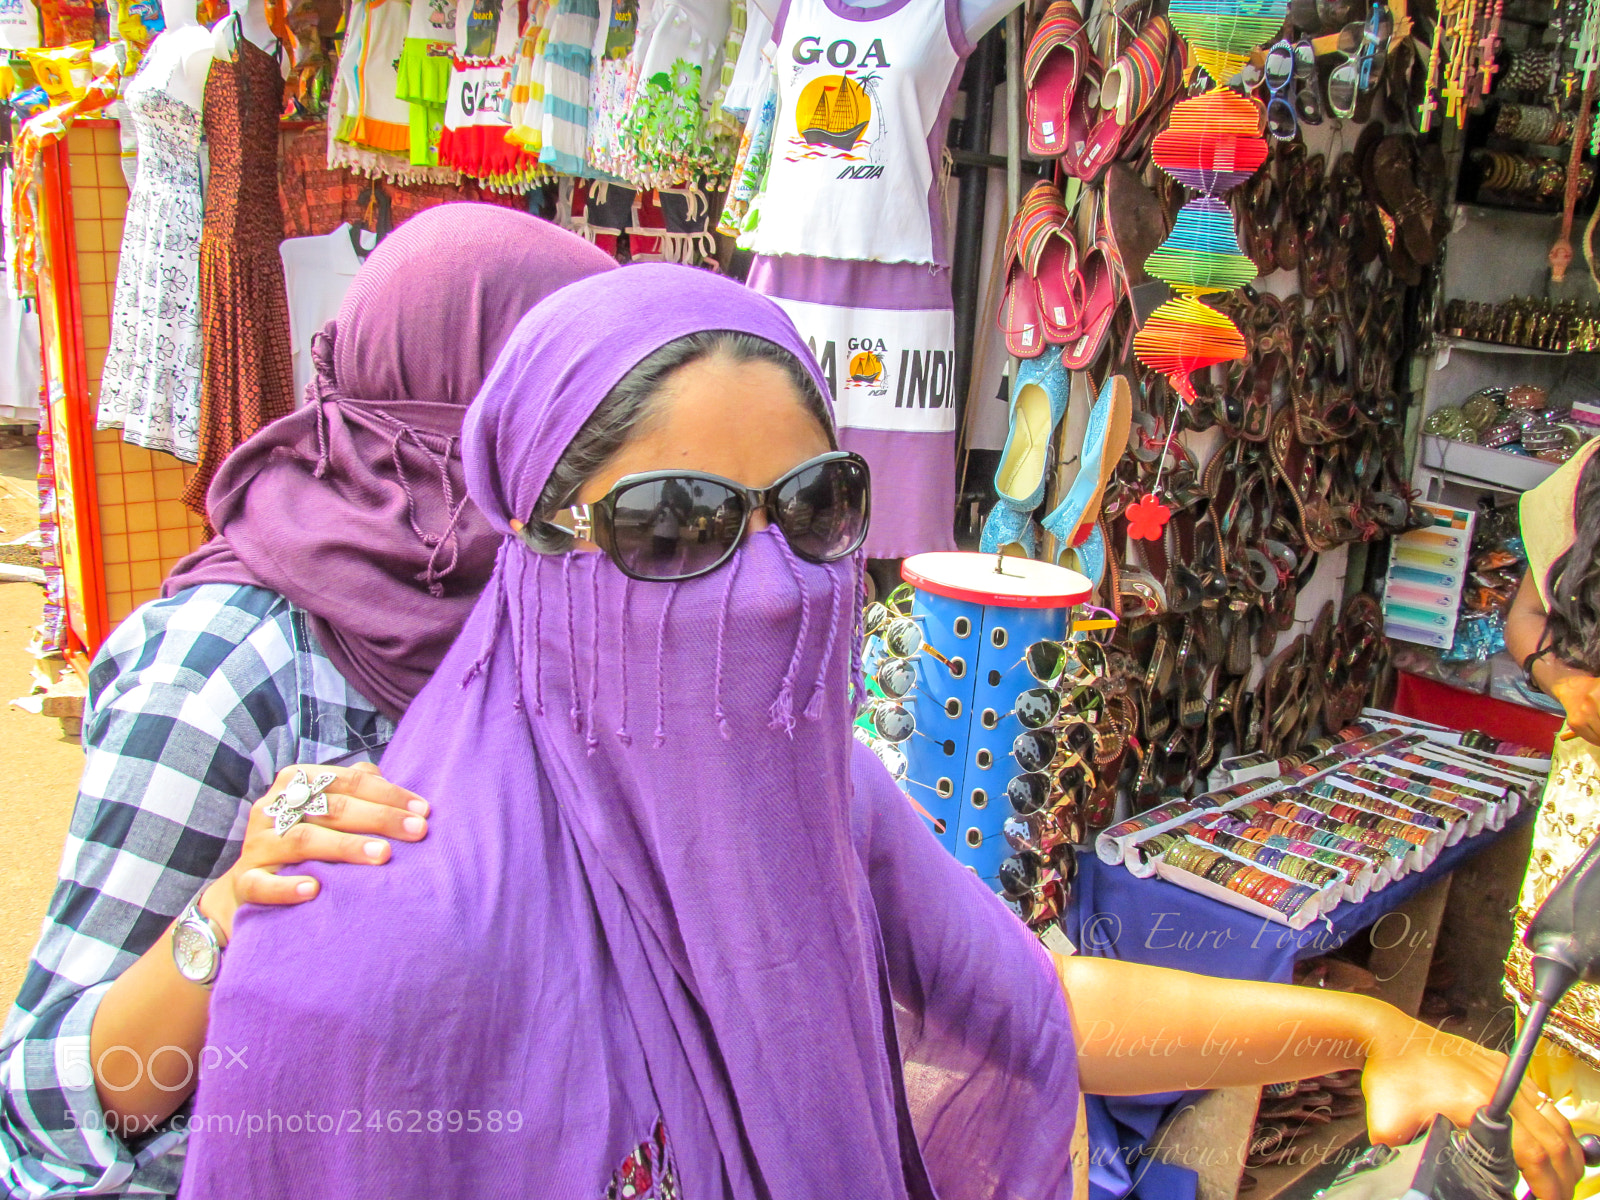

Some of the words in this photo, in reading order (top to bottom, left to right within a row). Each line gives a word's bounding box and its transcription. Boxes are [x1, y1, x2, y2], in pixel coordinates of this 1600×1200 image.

[792, 36, 891, 68] GOA
[836, 165, 885, 180] INDIA
[848, 337, 888, 351] GOA
[895, 349, 955, 409] INDI
